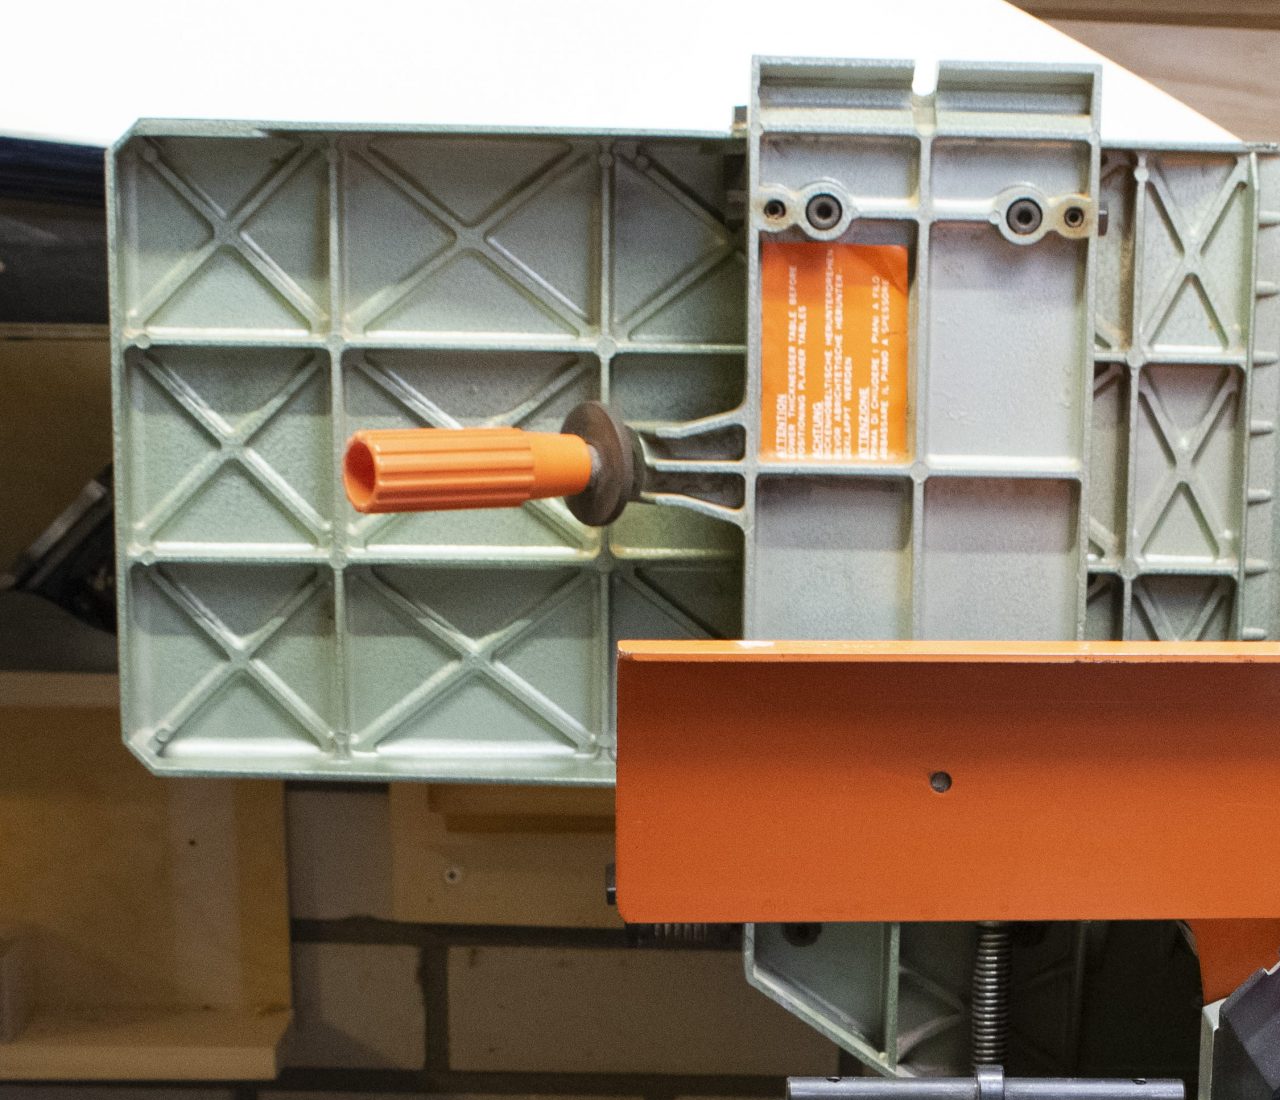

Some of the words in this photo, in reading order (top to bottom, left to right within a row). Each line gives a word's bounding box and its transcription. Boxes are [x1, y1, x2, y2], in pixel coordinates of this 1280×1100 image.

[789, 266, 797, 305] BEFORE
[788, 310, 797, 342] TABLE
[798, 306, 806, 344] TABLES
[798, 349, 806, 390] PLANER
